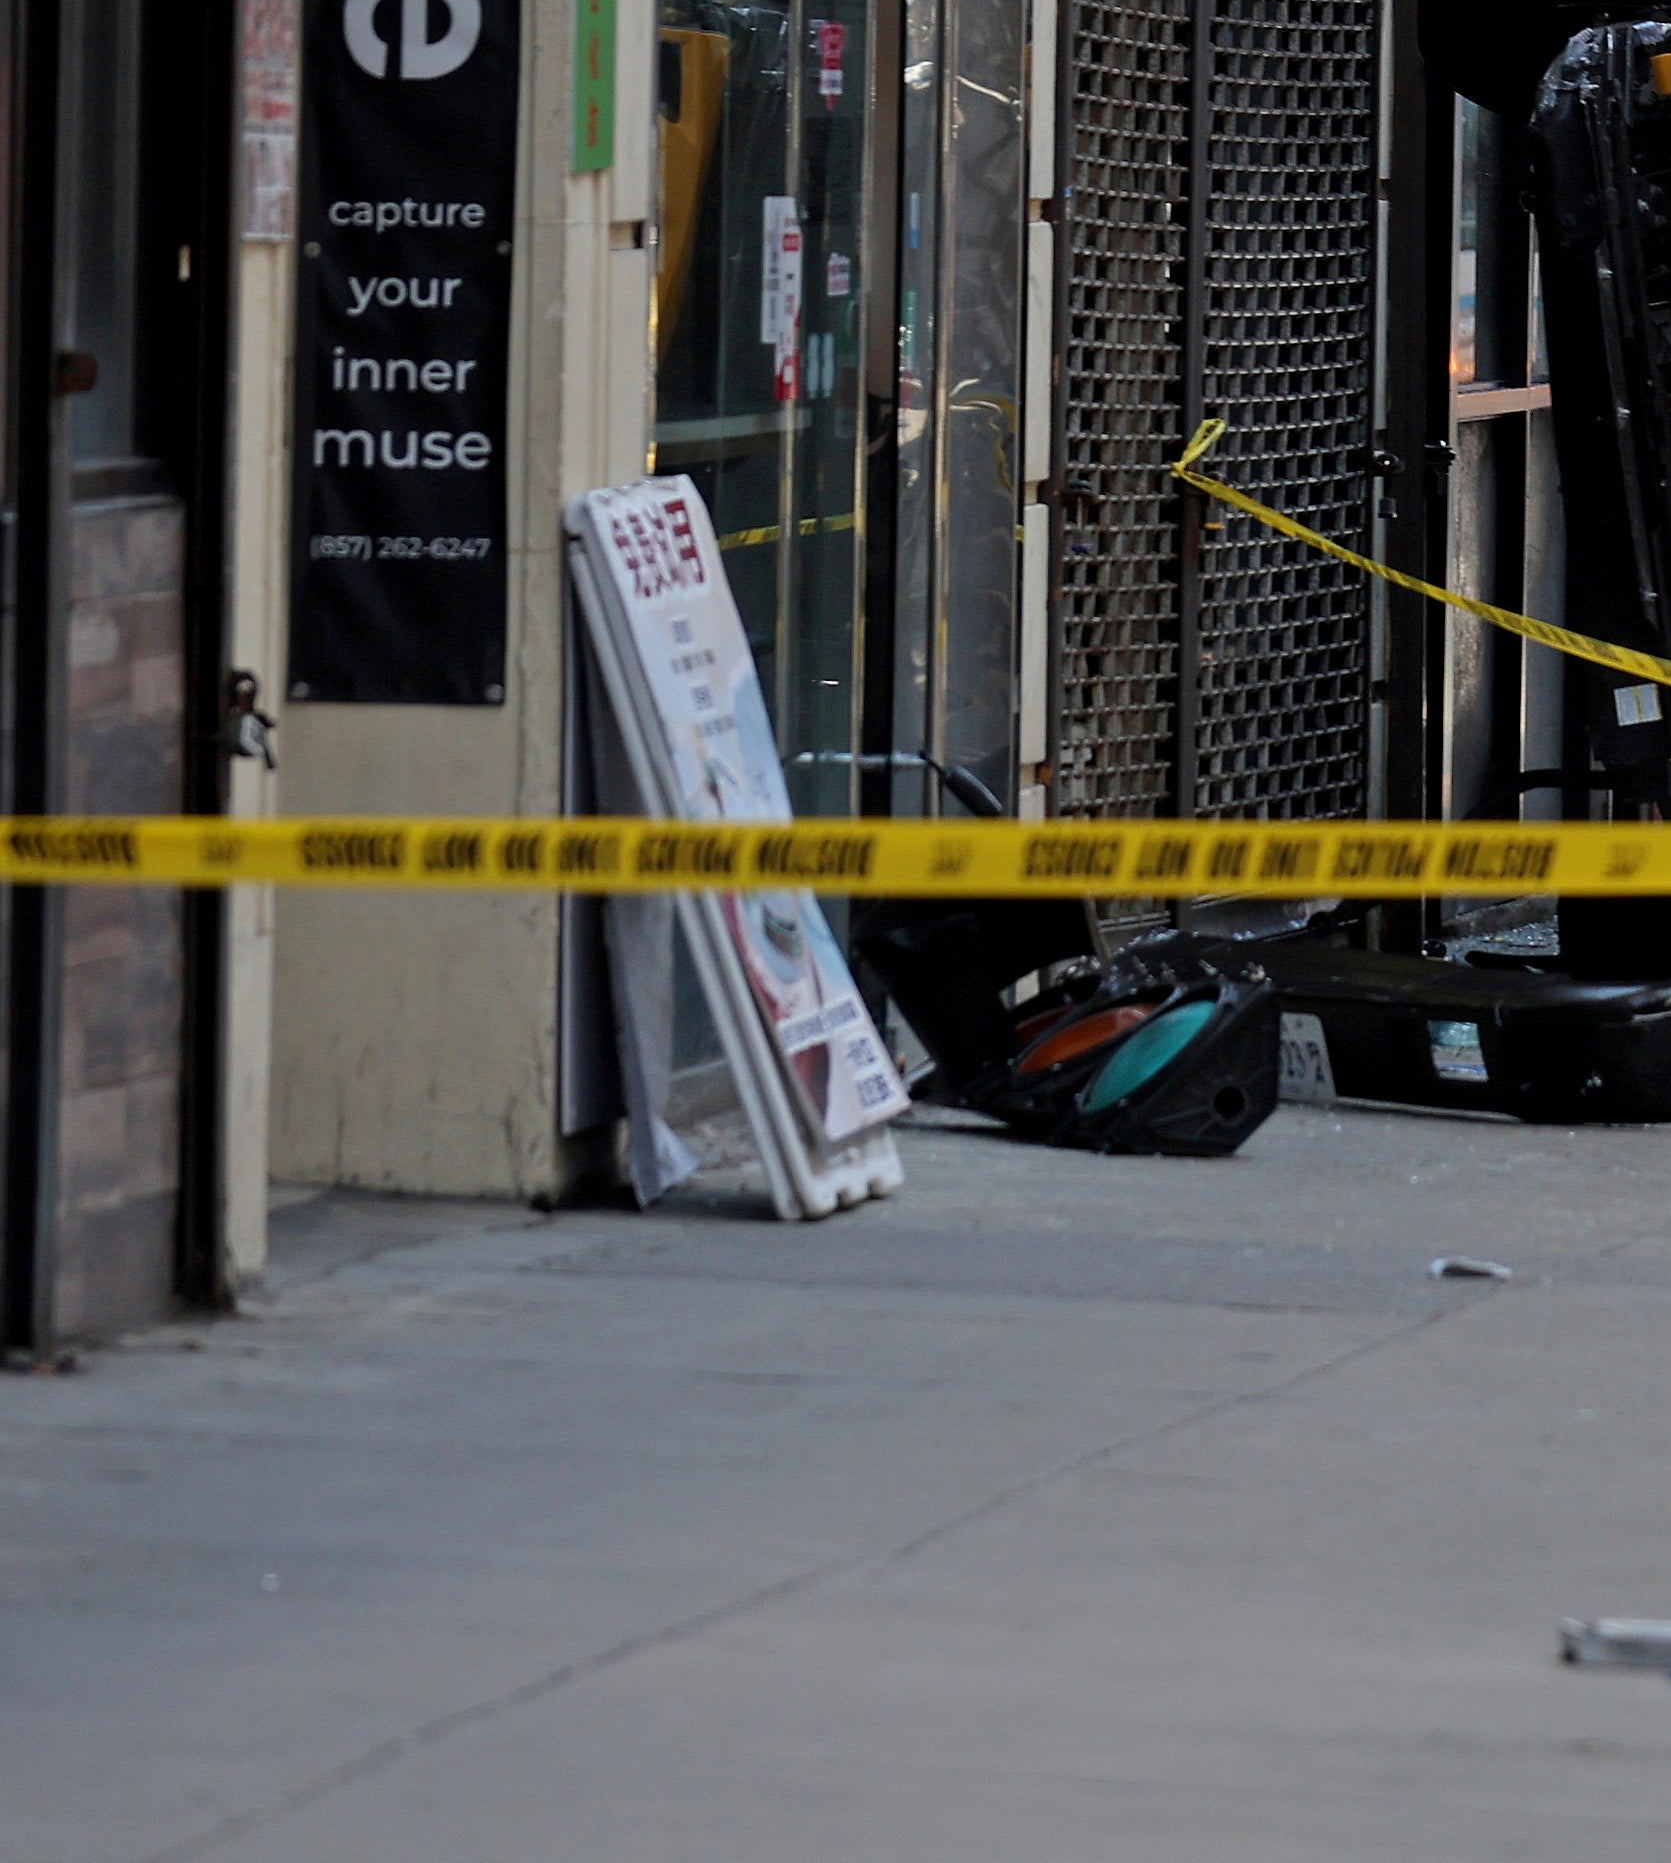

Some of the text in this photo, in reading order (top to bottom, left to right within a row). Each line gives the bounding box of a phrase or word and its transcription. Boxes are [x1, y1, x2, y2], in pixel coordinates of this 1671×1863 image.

[328, 197, 487, 234] capture
[346, 276, 463, 317] your
[332, 345, 478, 393] inner
[312, 428, 493, 470] muse
